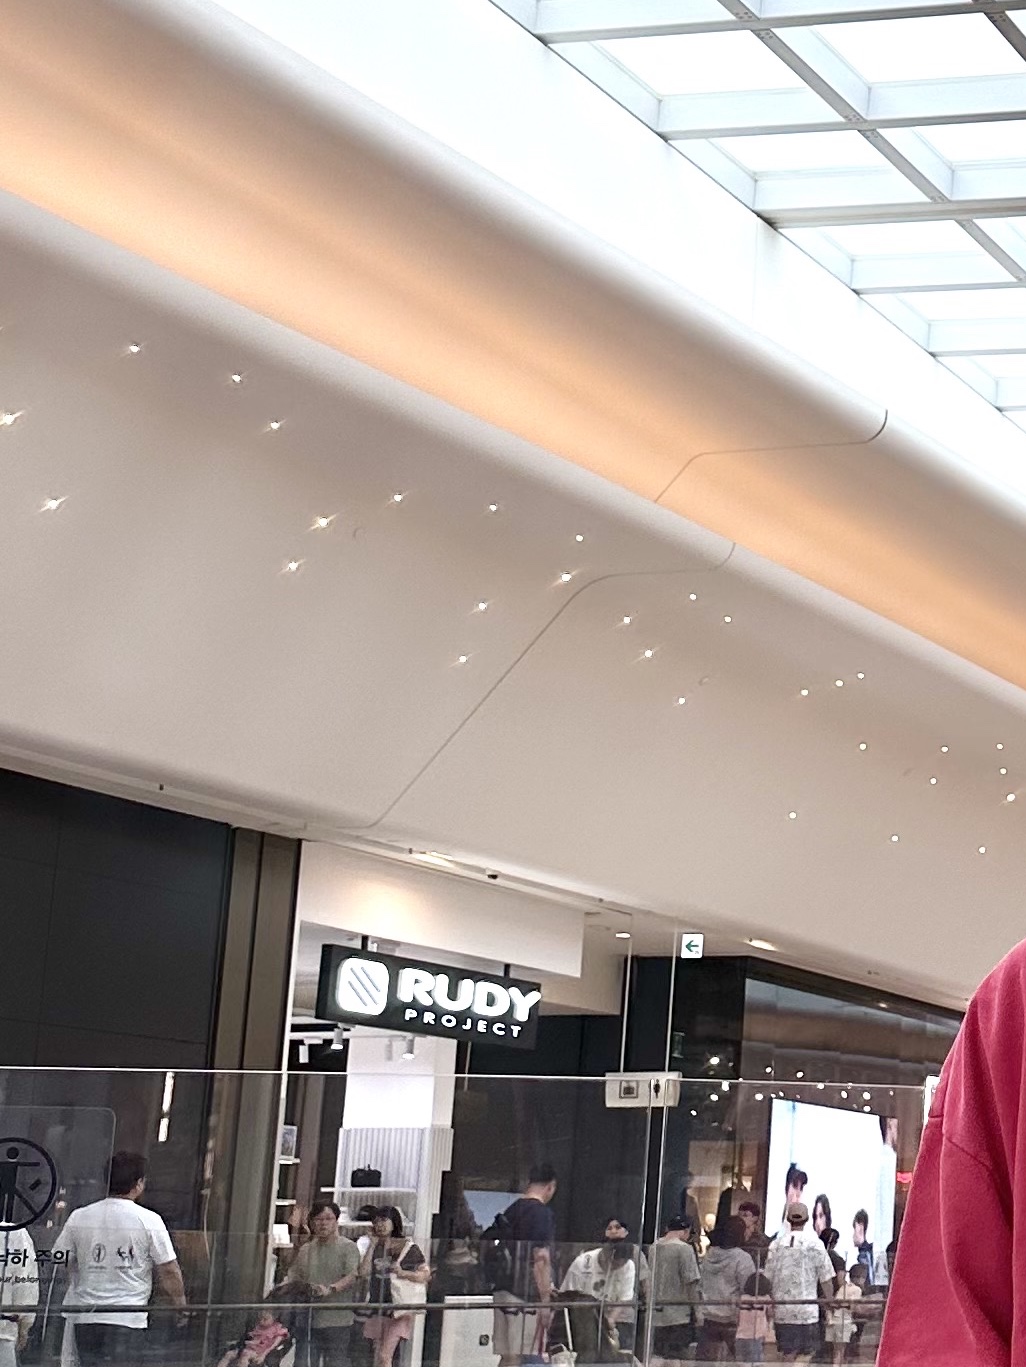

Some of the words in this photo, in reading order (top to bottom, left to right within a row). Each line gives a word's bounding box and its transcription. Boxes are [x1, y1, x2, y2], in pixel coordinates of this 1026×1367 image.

[396, 966, 542, 1022] RUDY
[404, 1008, 522, 1038] PROJECT
[34, 1249, 70, 1268] 주의
